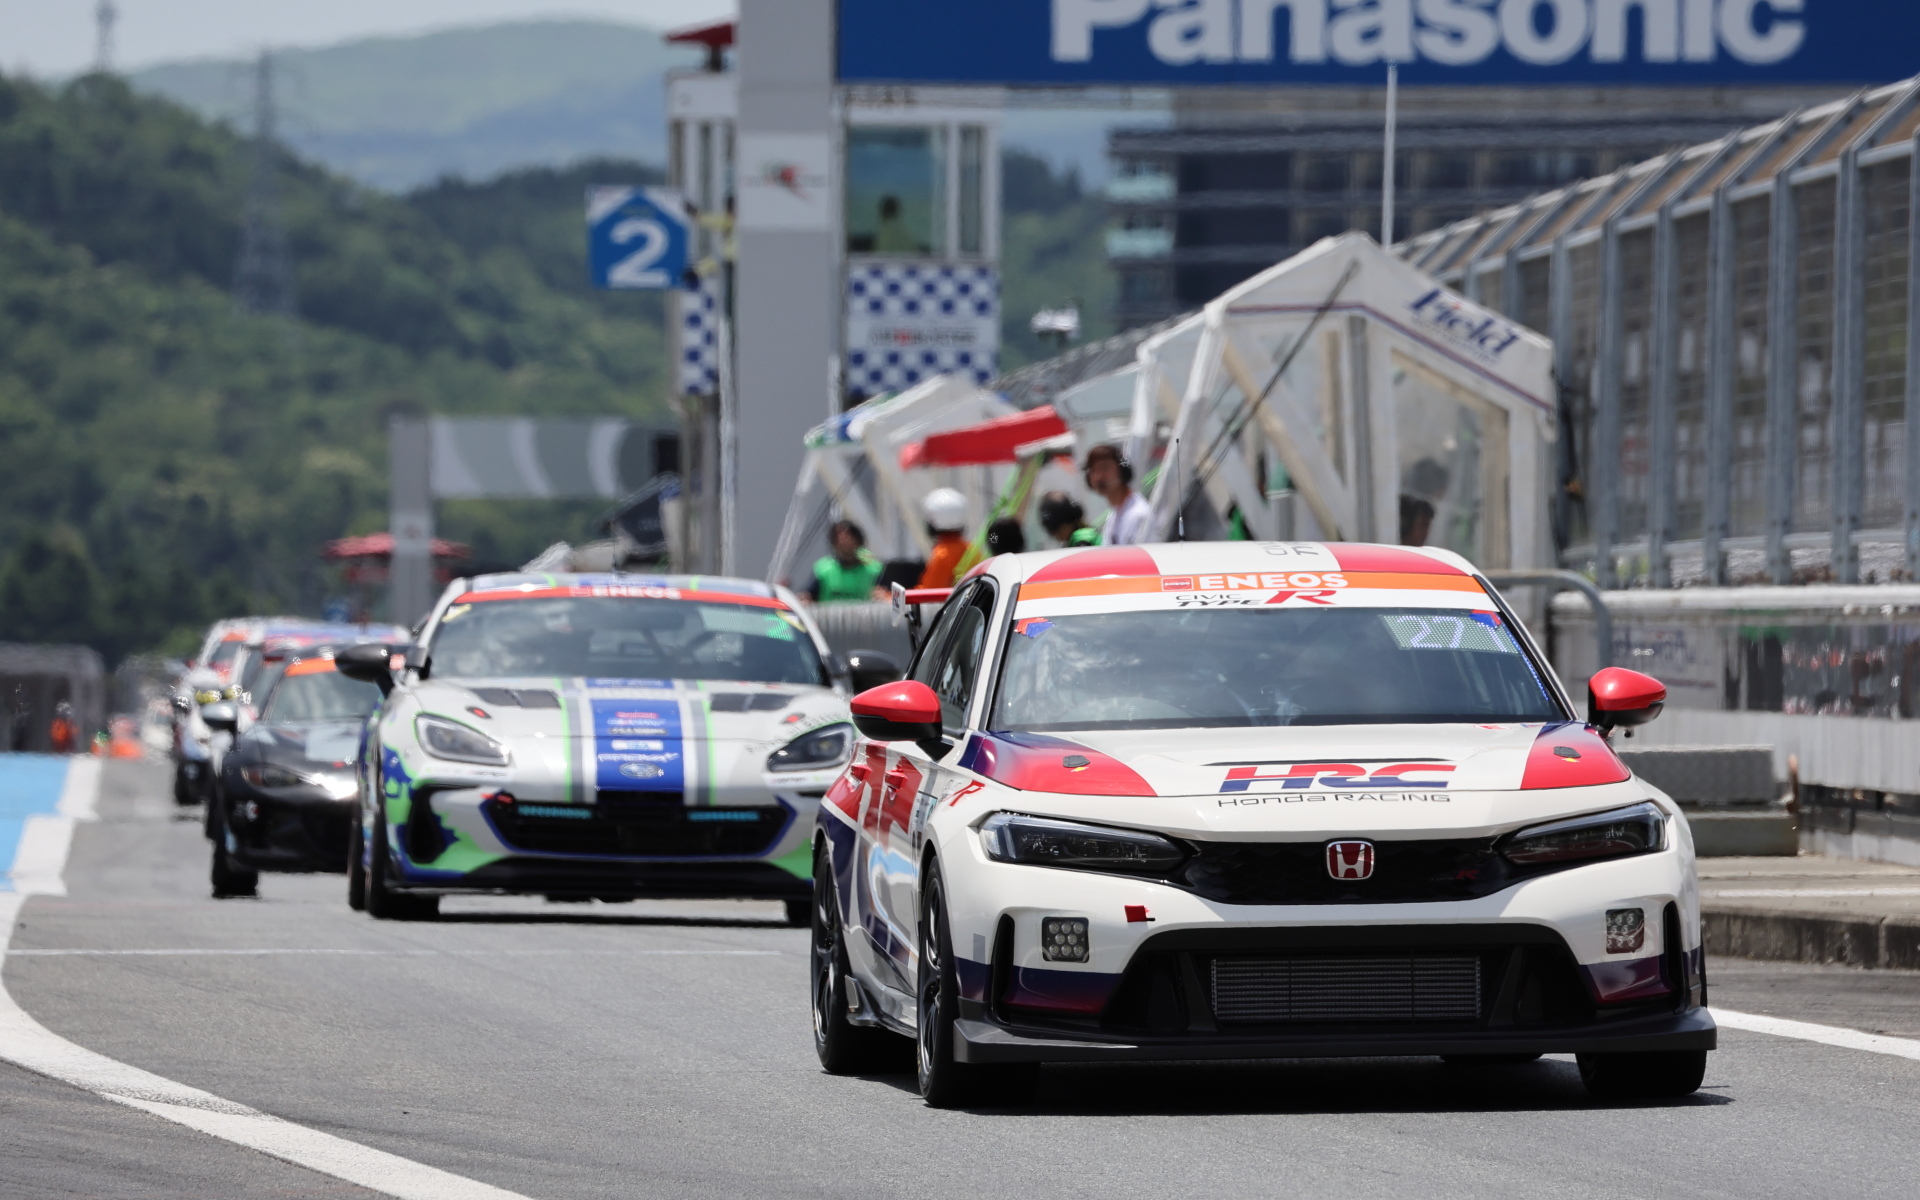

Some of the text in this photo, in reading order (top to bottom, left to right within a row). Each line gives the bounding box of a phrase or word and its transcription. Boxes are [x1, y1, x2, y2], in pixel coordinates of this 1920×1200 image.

[1051, 0, 1806, 65] Panasonic
[608, 219, 669, 288] 2
[1410, 289, 1520, 353] Field
[592, 585, 682, 600] ENEOS
[1199, 573, 1349, 590] ENEOS
[1176, 590, 1338, 607] TYPE R
[1219, 763, 1457, 793] HRC
[1217, 793, 1451, 808] Honda RACING
